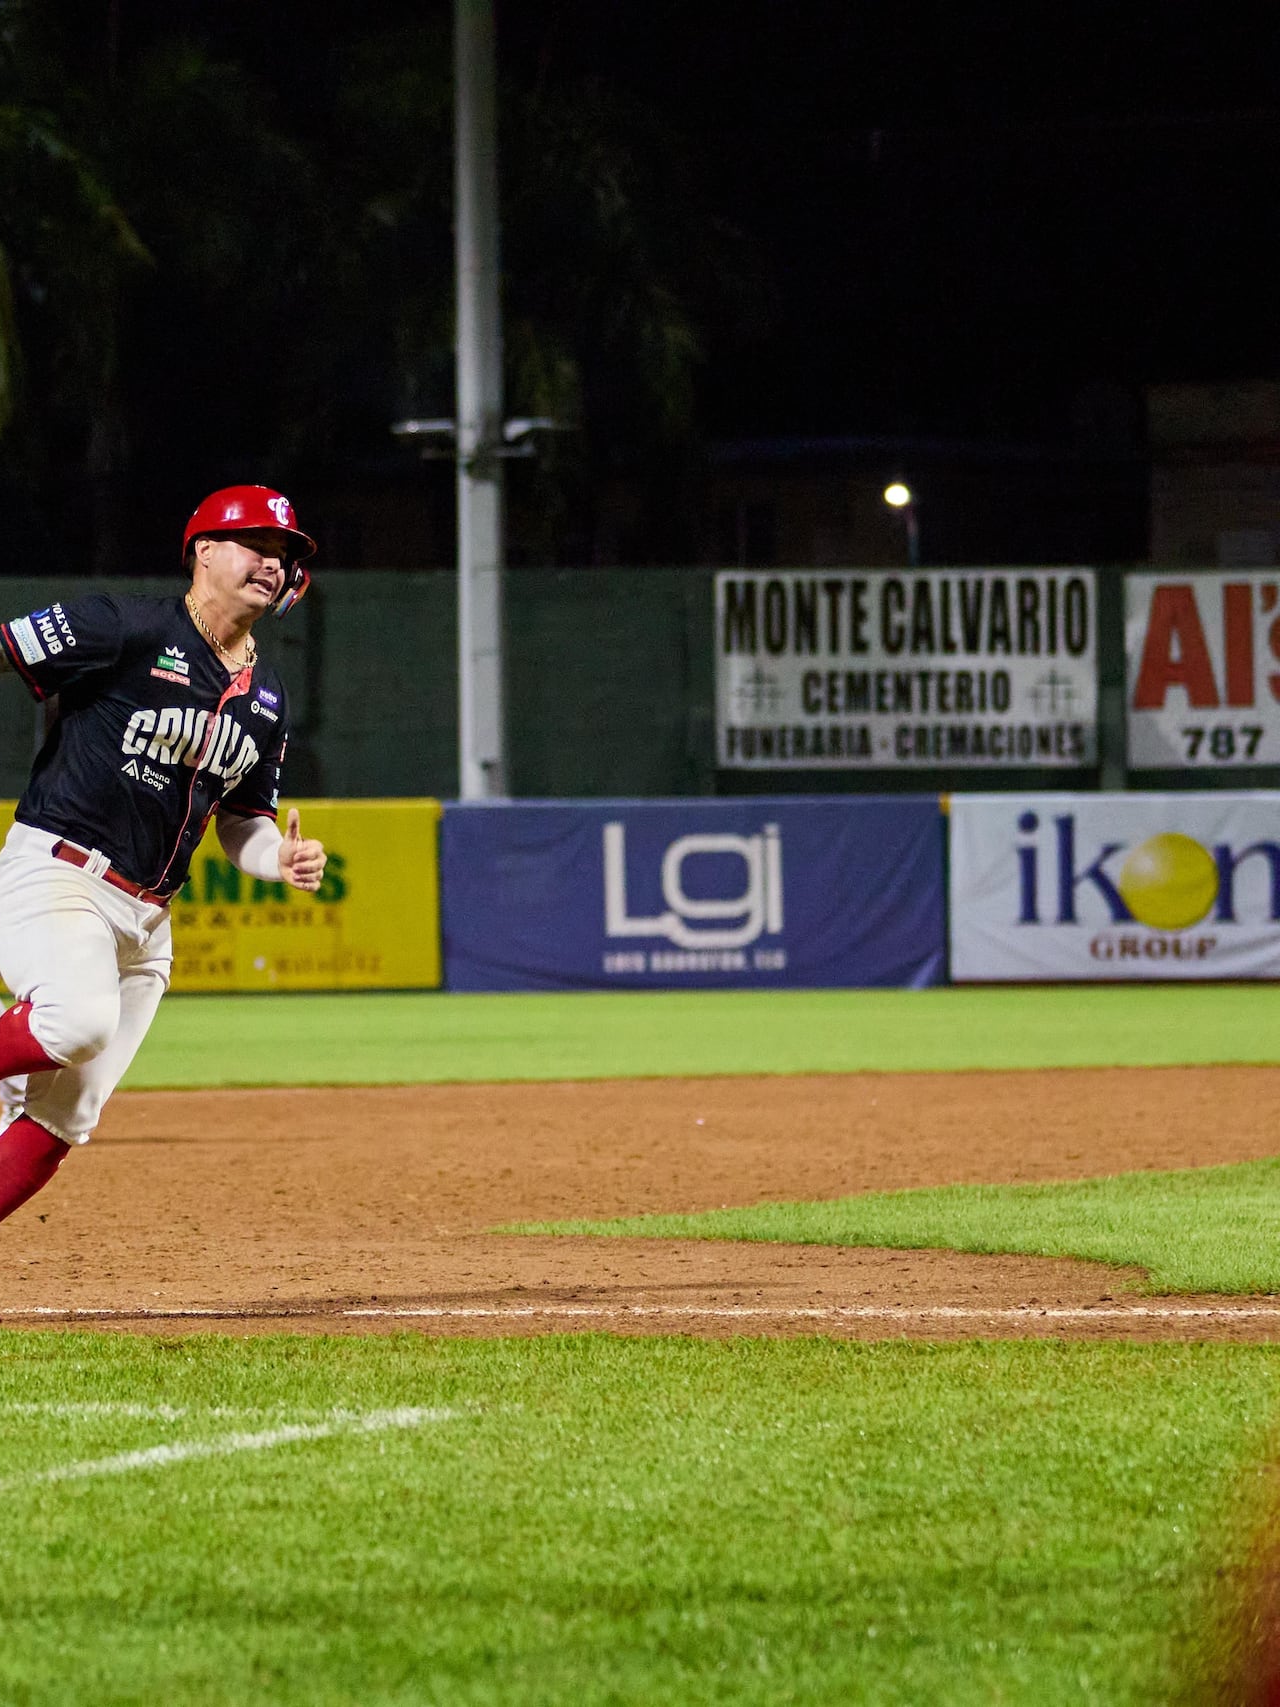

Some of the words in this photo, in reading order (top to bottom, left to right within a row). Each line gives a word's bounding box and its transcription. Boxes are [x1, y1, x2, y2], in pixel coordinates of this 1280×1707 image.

[36, 615, 64, 655] HUB
[723, 578, 870, 656] MONTE
[880, 577, 1089, 657] CALVARIO
[802, 670, 1012, 714] CEMENTERIO
[726, 725, 872, 760] FUNERARIA
[895, 724, 1086, 760] CREMACIONES
[1181, 726, 1265, 761] 787
[141, 774, 164, 792] Coop
[143, 764, 171, 785] Buena
[603, 822, 784, 950] Lgi
[1088, 936, 1217, 961] GROUP
